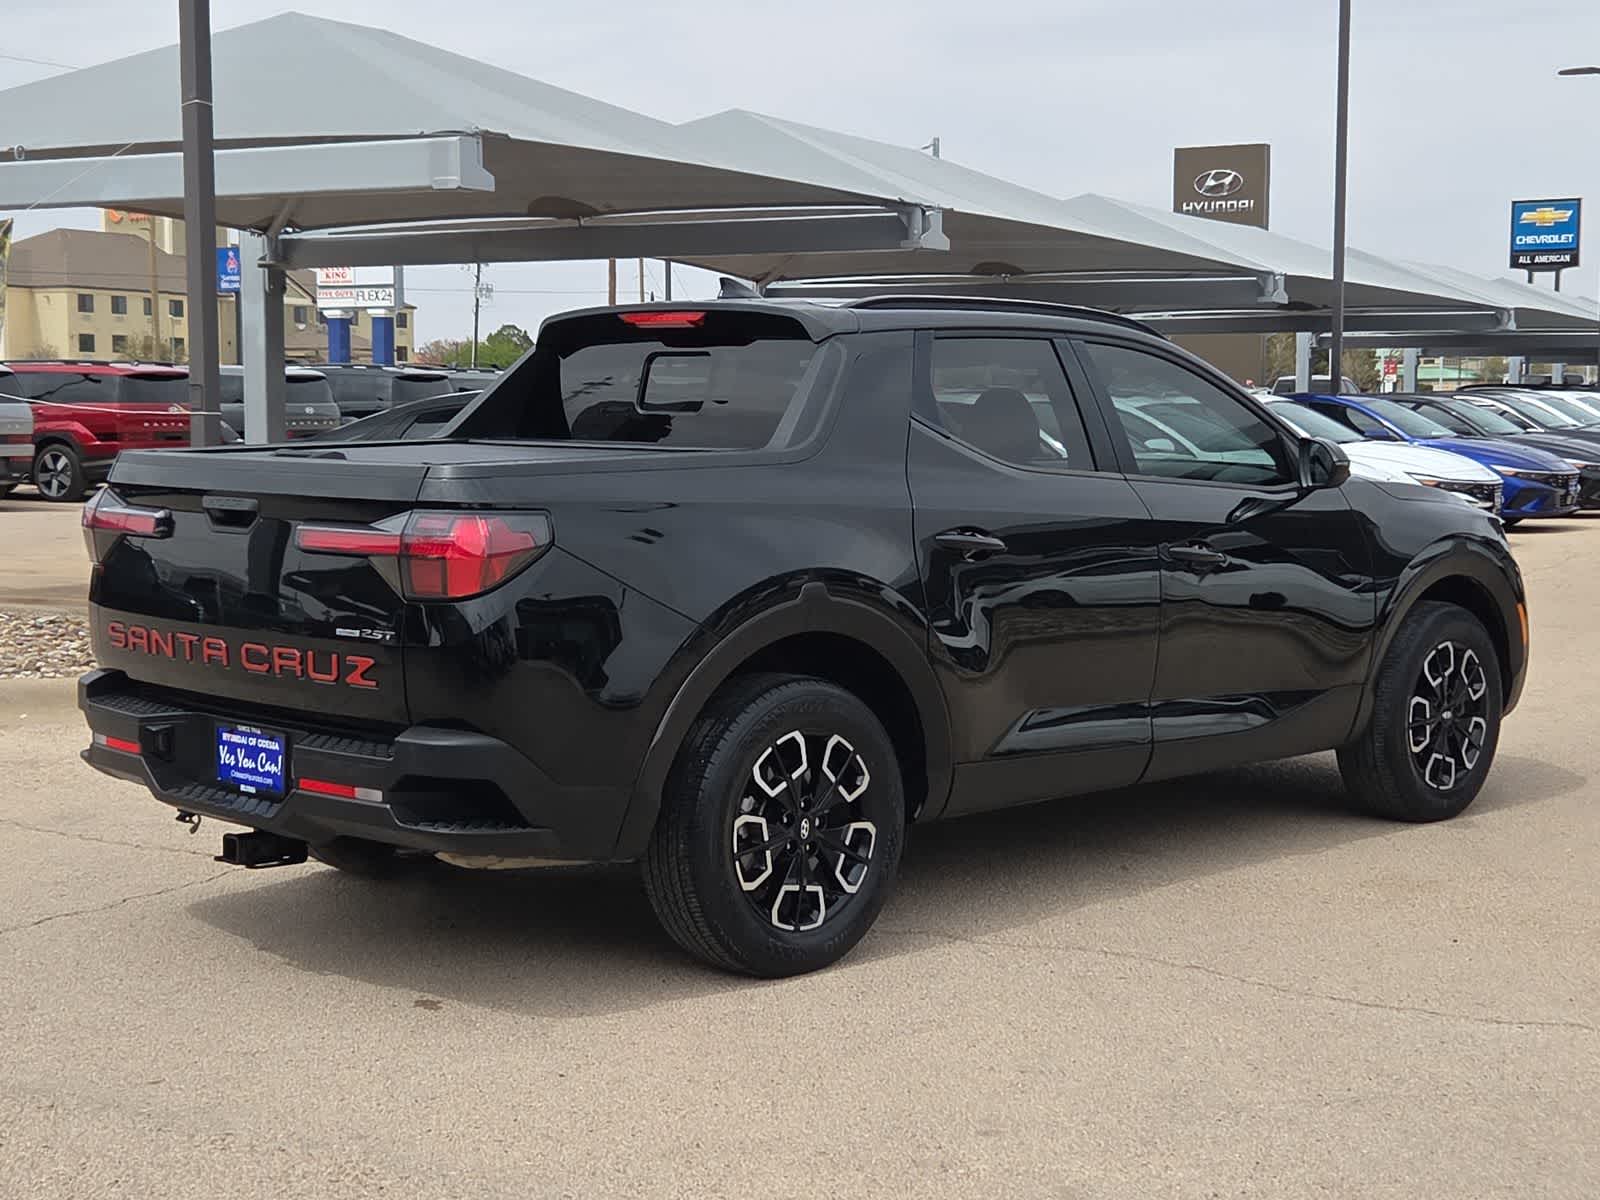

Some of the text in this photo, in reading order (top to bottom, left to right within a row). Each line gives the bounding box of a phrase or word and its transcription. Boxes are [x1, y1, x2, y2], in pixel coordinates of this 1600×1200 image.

[1182, 199, 1254, 213] HYUNDAI
[1516, 234, 1574, 245] CHEVROLET
[1518, 254, 1571, 264] ALL AMERICAN
[325, 271, 347, 279] KING
[107, 621, 379, 690] SANTA CRUZ
[248, 736, 257, 746] OF
[219, 744, 282, 775] Yes You Can!
